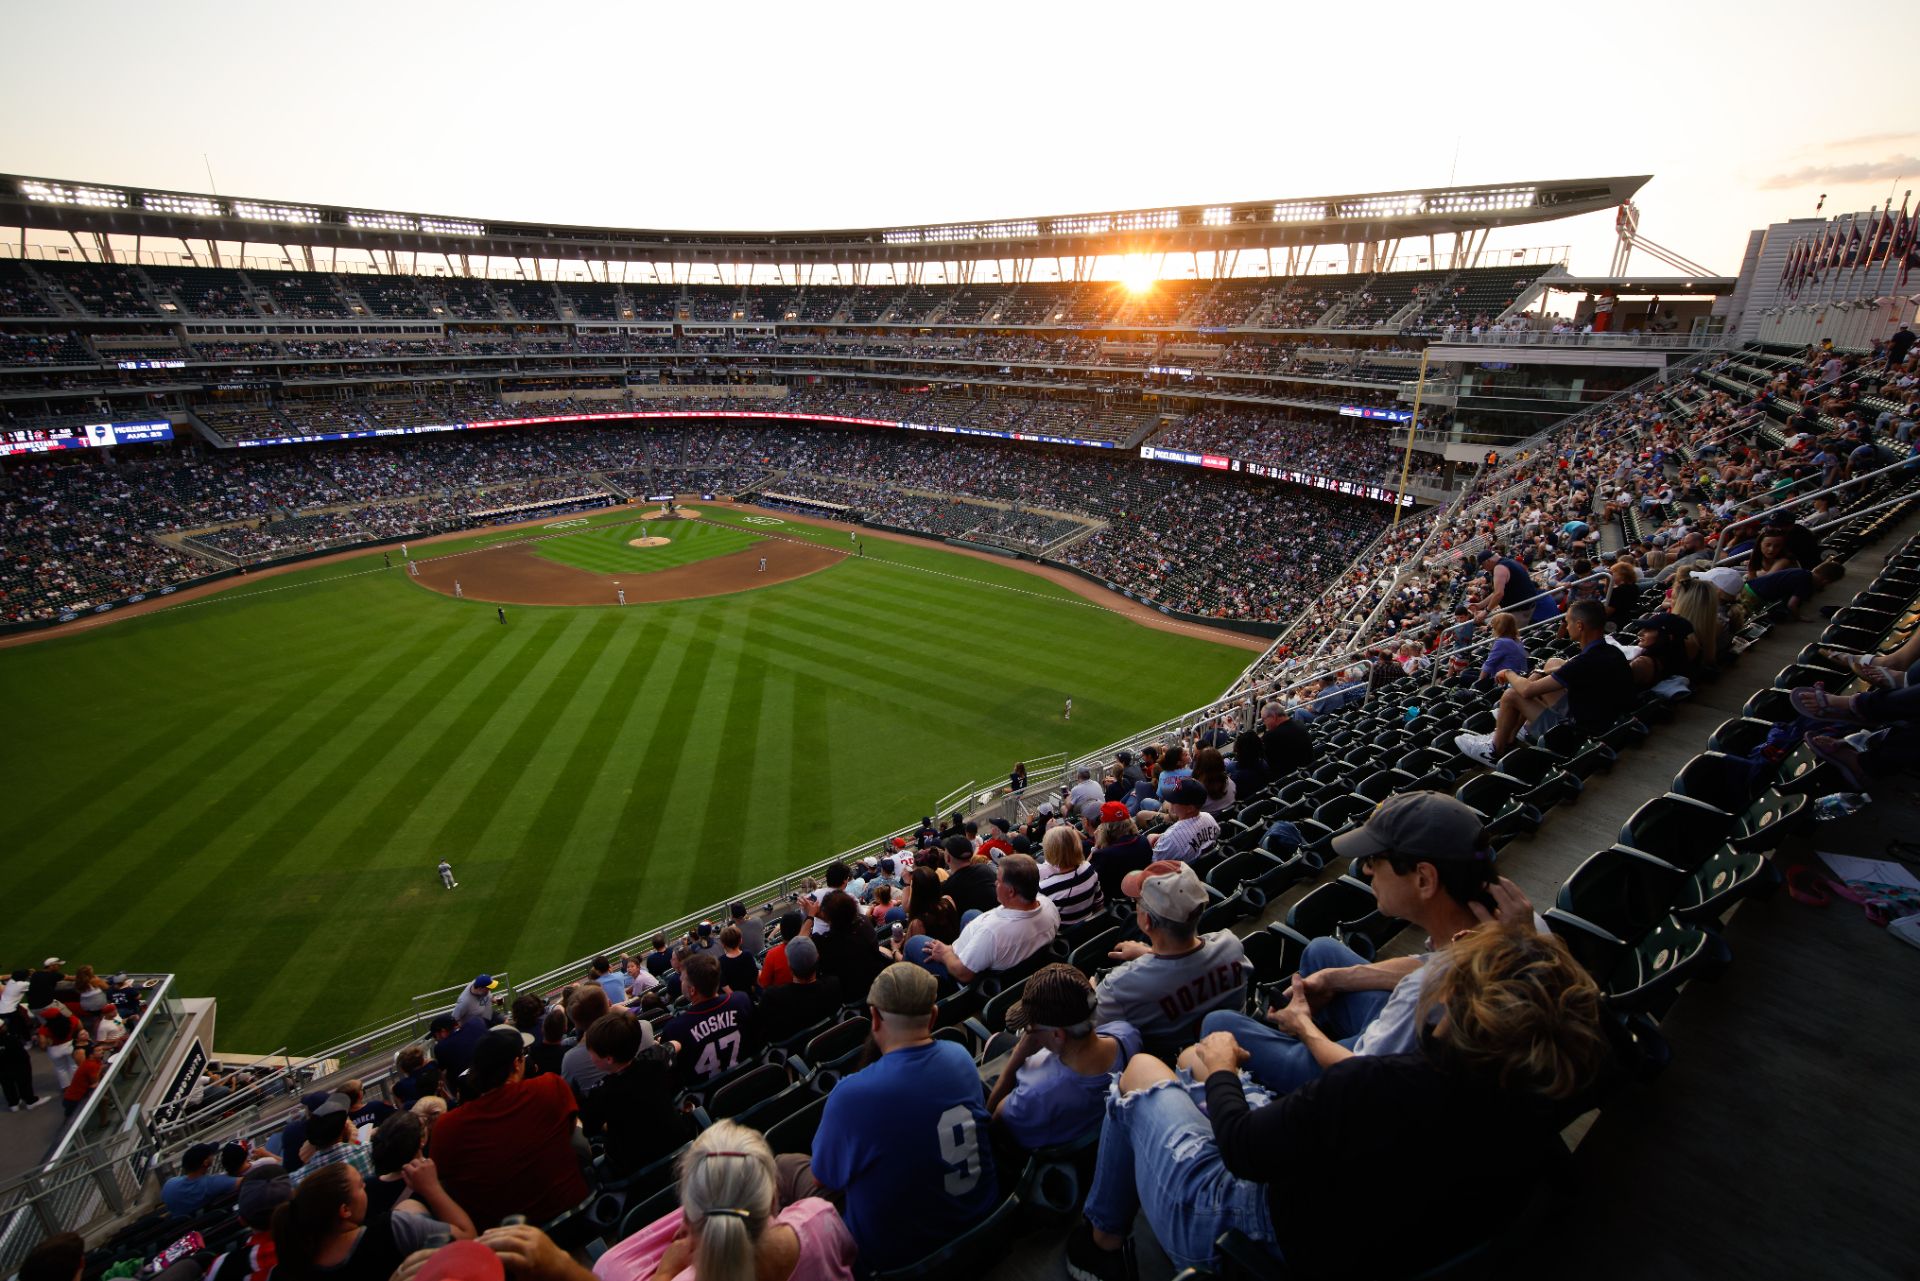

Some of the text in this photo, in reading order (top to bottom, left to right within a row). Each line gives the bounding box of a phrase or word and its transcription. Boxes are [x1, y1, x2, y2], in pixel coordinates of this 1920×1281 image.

[1159, 961, 1243, 1022] DOZIER
[690, 1010, 738, 1042] KOSKIE
[694, 1029, 741, 1080] 47
[937, 1103, 982, 1197] 9
